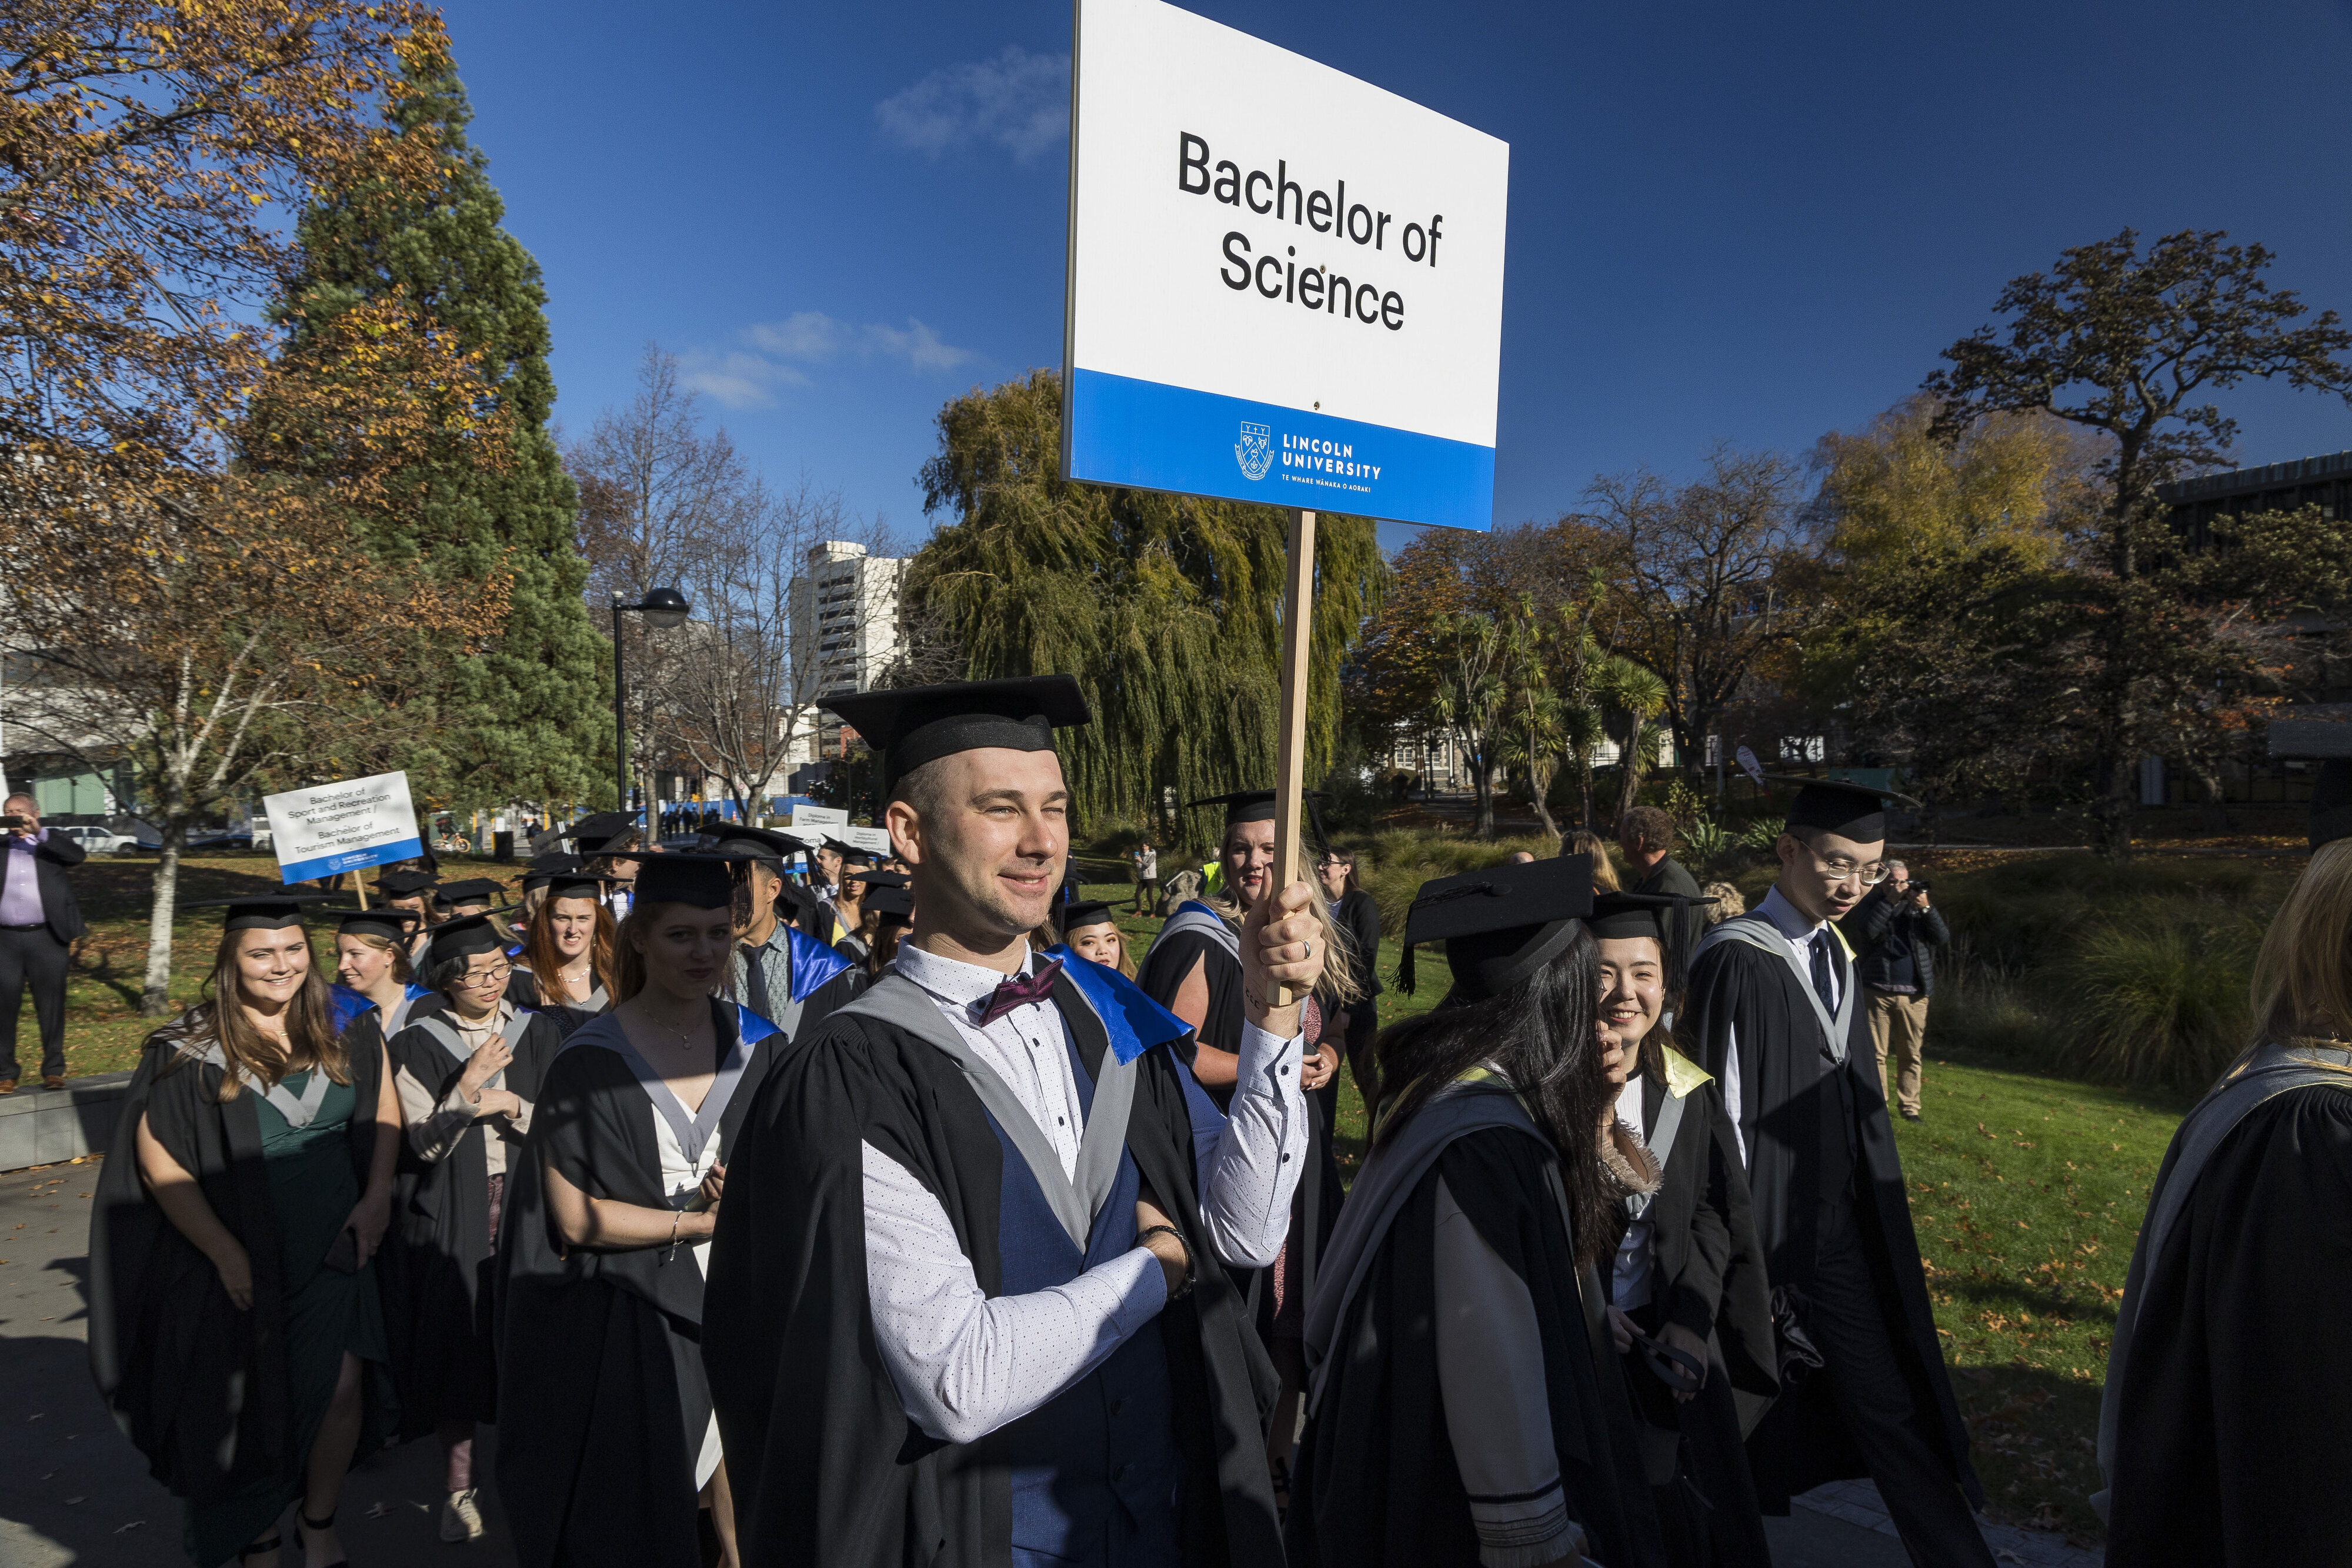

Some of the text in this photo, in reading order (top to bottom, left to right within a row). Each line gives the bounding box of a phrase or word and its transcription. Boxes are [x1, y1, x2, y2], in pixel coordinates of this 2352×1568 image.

[1179, 131, 1443, 268] Bachelor of
[1220, 231, 1404, 331] Science
[1283, 433, 1352, 458] LINCOLN
[1282, 451, 1381, 480] UNIVERSITY
[1292, 475, 1313, 484] WHARE
[1316, 478, 1341, 488] WĀNAKA
[1349, 484, 1370, 493] AORAKI
[288, 794, 391, 819] Sport and Recreation
[309, 787, 366, 805] Bachelor of
[306, 806, 371, 826] Management
[295, 827, 401, 854] Tourism Management
[318, 822, 373, 839] Bachelor of
